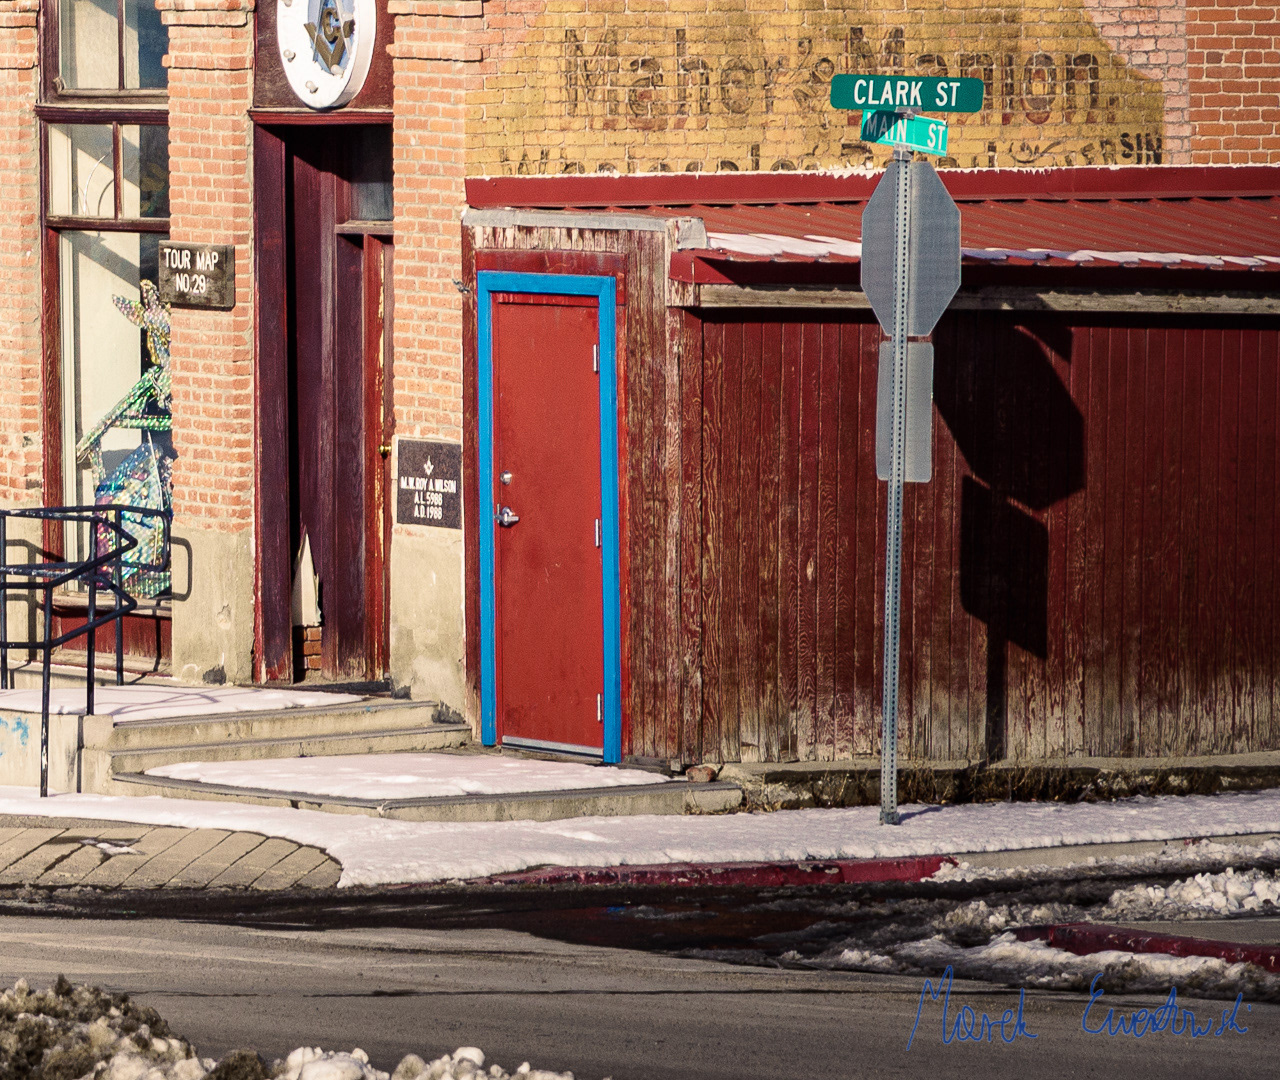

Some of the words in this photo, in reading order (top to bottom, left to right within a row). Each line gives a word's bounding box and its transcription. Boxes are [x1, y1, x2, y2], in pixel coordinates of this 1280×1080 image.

[853, 79, 923, 106] CLARK
[935, 81, 961, 107] ST
[866, 111, 908, 143] MAIN
[926, 123, 946, 150] ST
[163, 248, 191, 270] TOUR
[196, 251, 219, 271] MAP
[435, 479, 457, 493] WILSON
[427, 493, 443, 506] 5988
[427, 507, 443, 520] 1988
